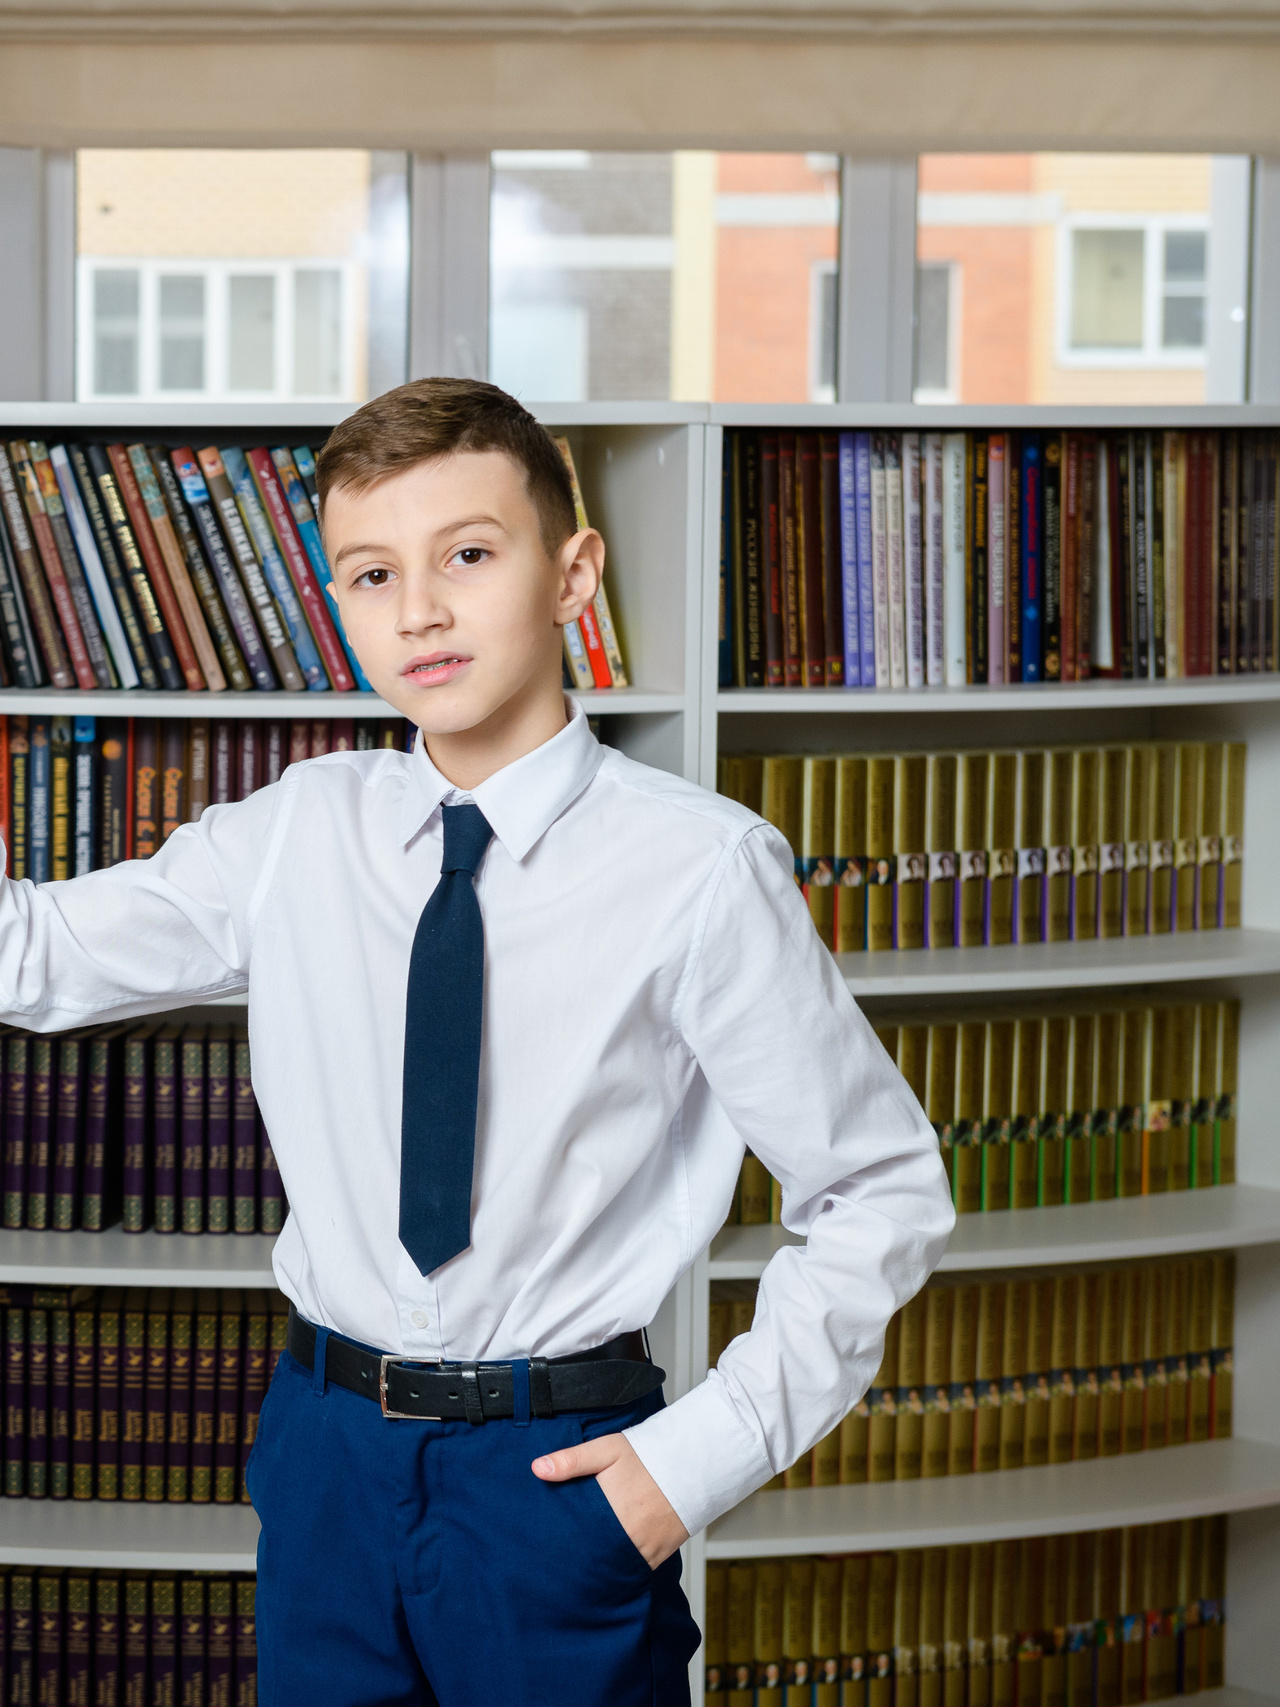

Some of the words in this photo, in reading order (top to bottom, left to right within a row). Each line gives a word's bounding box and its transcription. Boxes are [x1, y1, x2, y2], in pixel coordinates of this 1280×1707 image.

[992, 502, 1004, 535] ТЕЛО
[219, 496, 254, 562] ВЕЛИКИЕ
[242, 561, 270, 607] ЛЮДИ
[259, 605, 285, 648] МИРА
[991, 539, 1004, 607] ЧЕЛОВЕКА
[184, 538, 212, 597] ИСТОРИЯ
[206, 597, 238, 666] РЫЦАРСТВА
[136, 766, 155, 816] Сказки
[162, 767, 183, 817] Сказки
[13, 805, 24, 834] ДЕТИ
